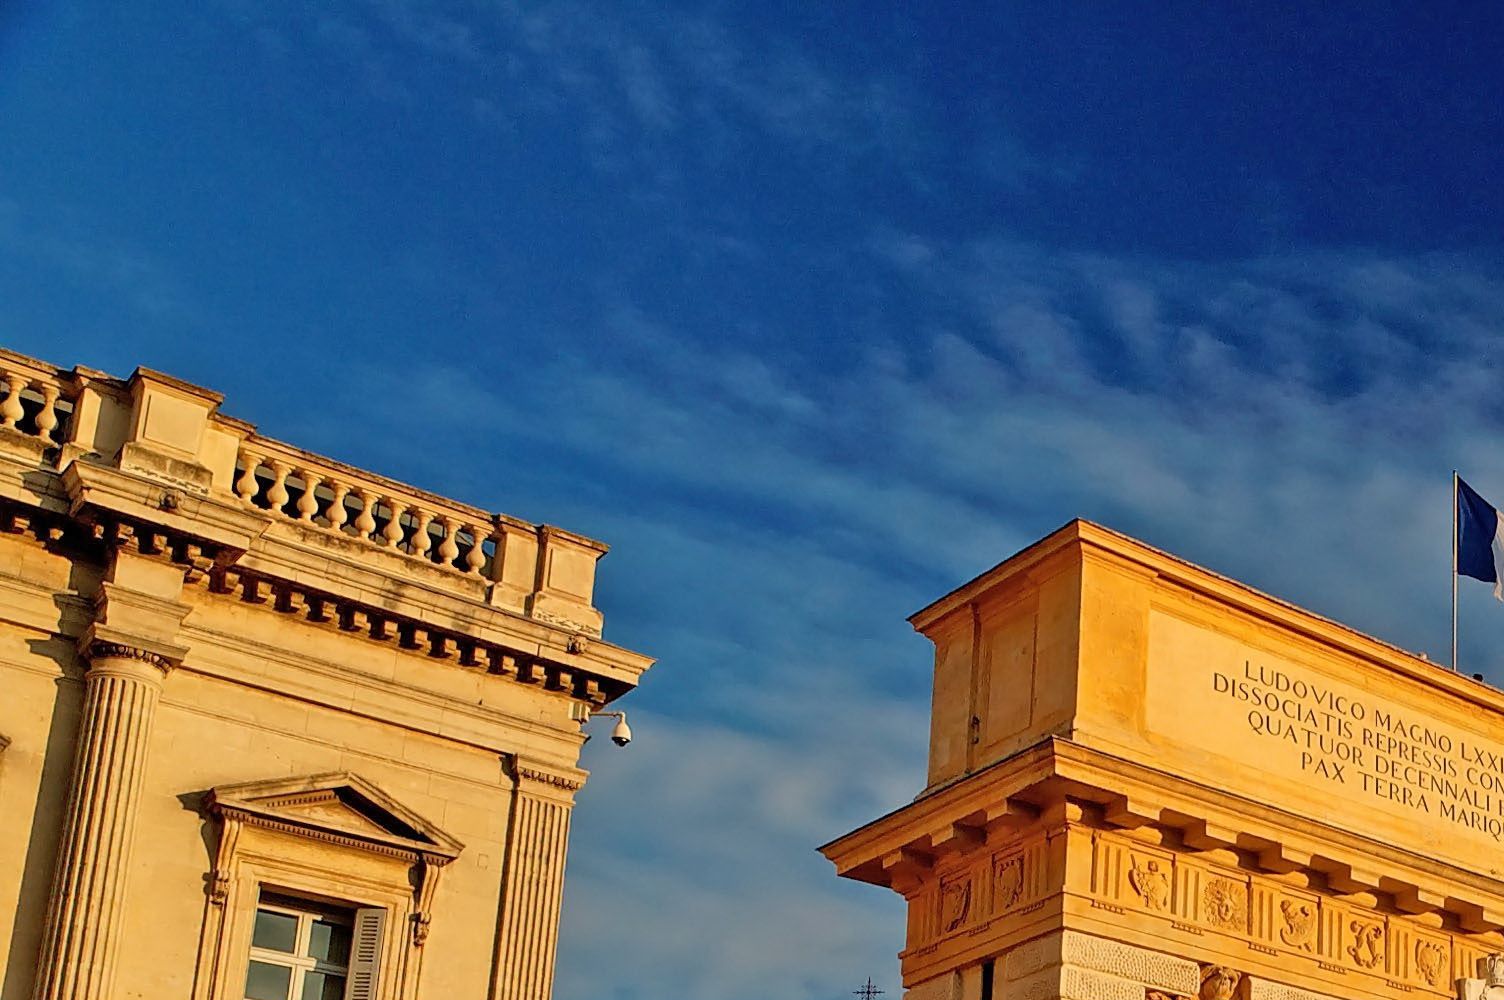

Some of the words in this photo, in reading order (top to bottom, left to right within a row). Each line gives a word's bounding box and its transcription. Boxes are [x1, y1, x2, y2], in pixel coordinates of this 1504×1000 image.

[1213, 672, 1353, 739] DISSOCIATIS
[1363, 728, 1457, 777] REPRESSIS
[1245, 660, 1365, 720] LUDOVICO
[1375, 709, 1452, 753] MAGNO
[1248, 710, 1364, 767] QUATUOR
[1375, 755, 1490, 812] DECENNALI
[1302, 752, 1345, 783] PAX
[1357, 771, 1429, 812] TERRA
